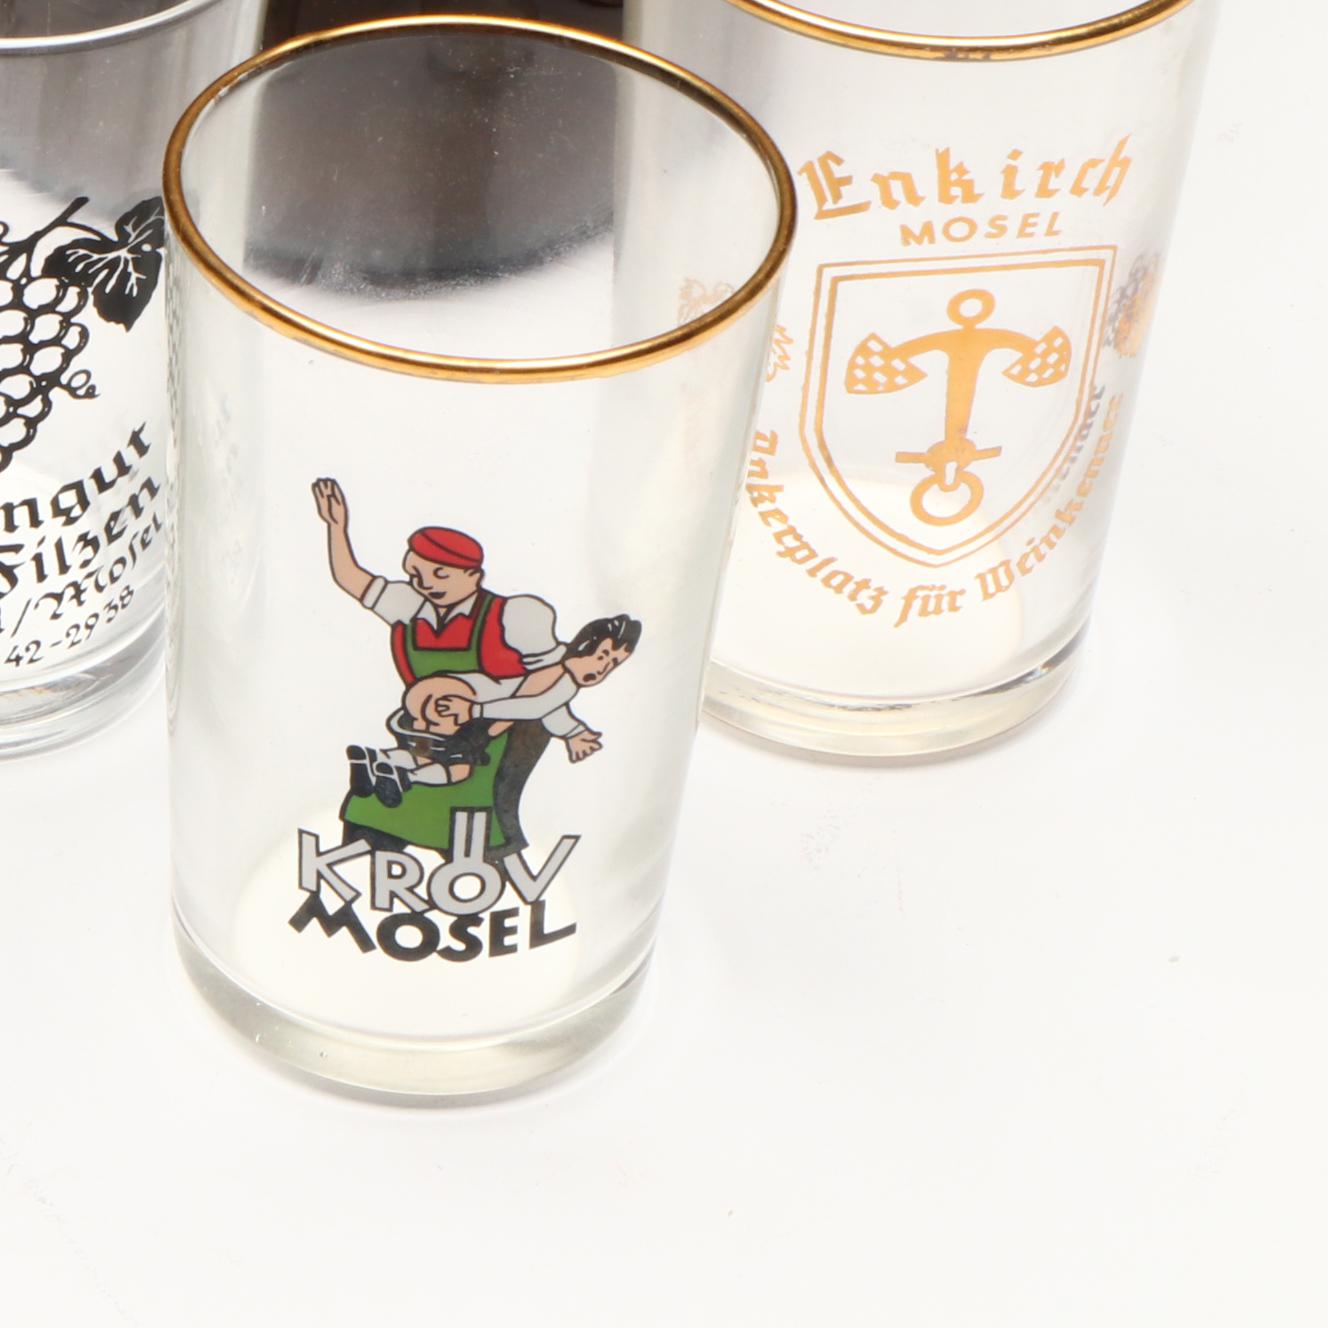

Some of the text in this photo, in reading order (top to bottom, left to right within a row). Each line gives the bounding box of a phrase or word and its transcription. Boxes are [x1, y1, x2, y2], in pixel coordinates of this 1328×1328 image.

[796, 132, 1132, 221] Enkirch
[899, 210, 1064, 247] MOSEL
[893, 583, 967, 629] für
[297, 805, 583, 918] KRÖV
[287, 892, 578, 963] MOSEL
